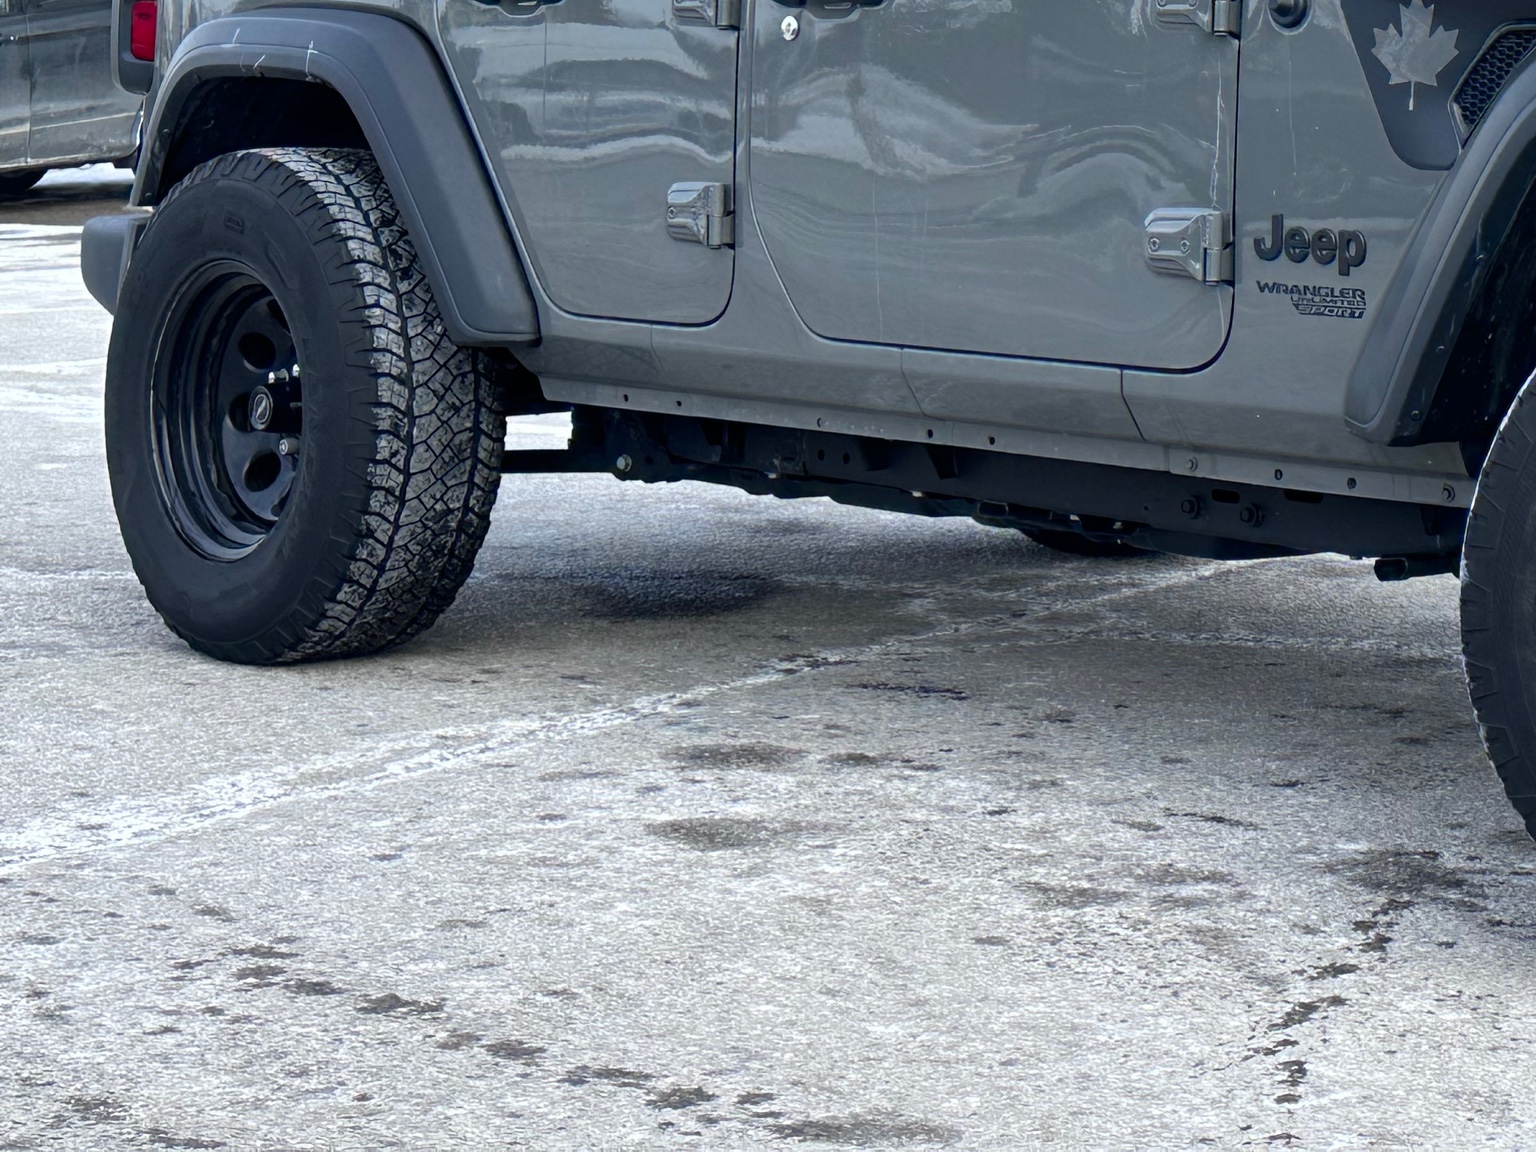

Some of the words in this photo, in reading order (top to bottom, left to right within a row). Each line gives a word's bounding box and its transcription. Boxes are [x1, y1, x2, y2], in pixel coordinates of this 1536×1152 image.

[1253, 213, 1368, 277] Jeep
[1256, 280, 1367, 301] WRANGLER
[1295, 304, 1365, 319] SPORT
